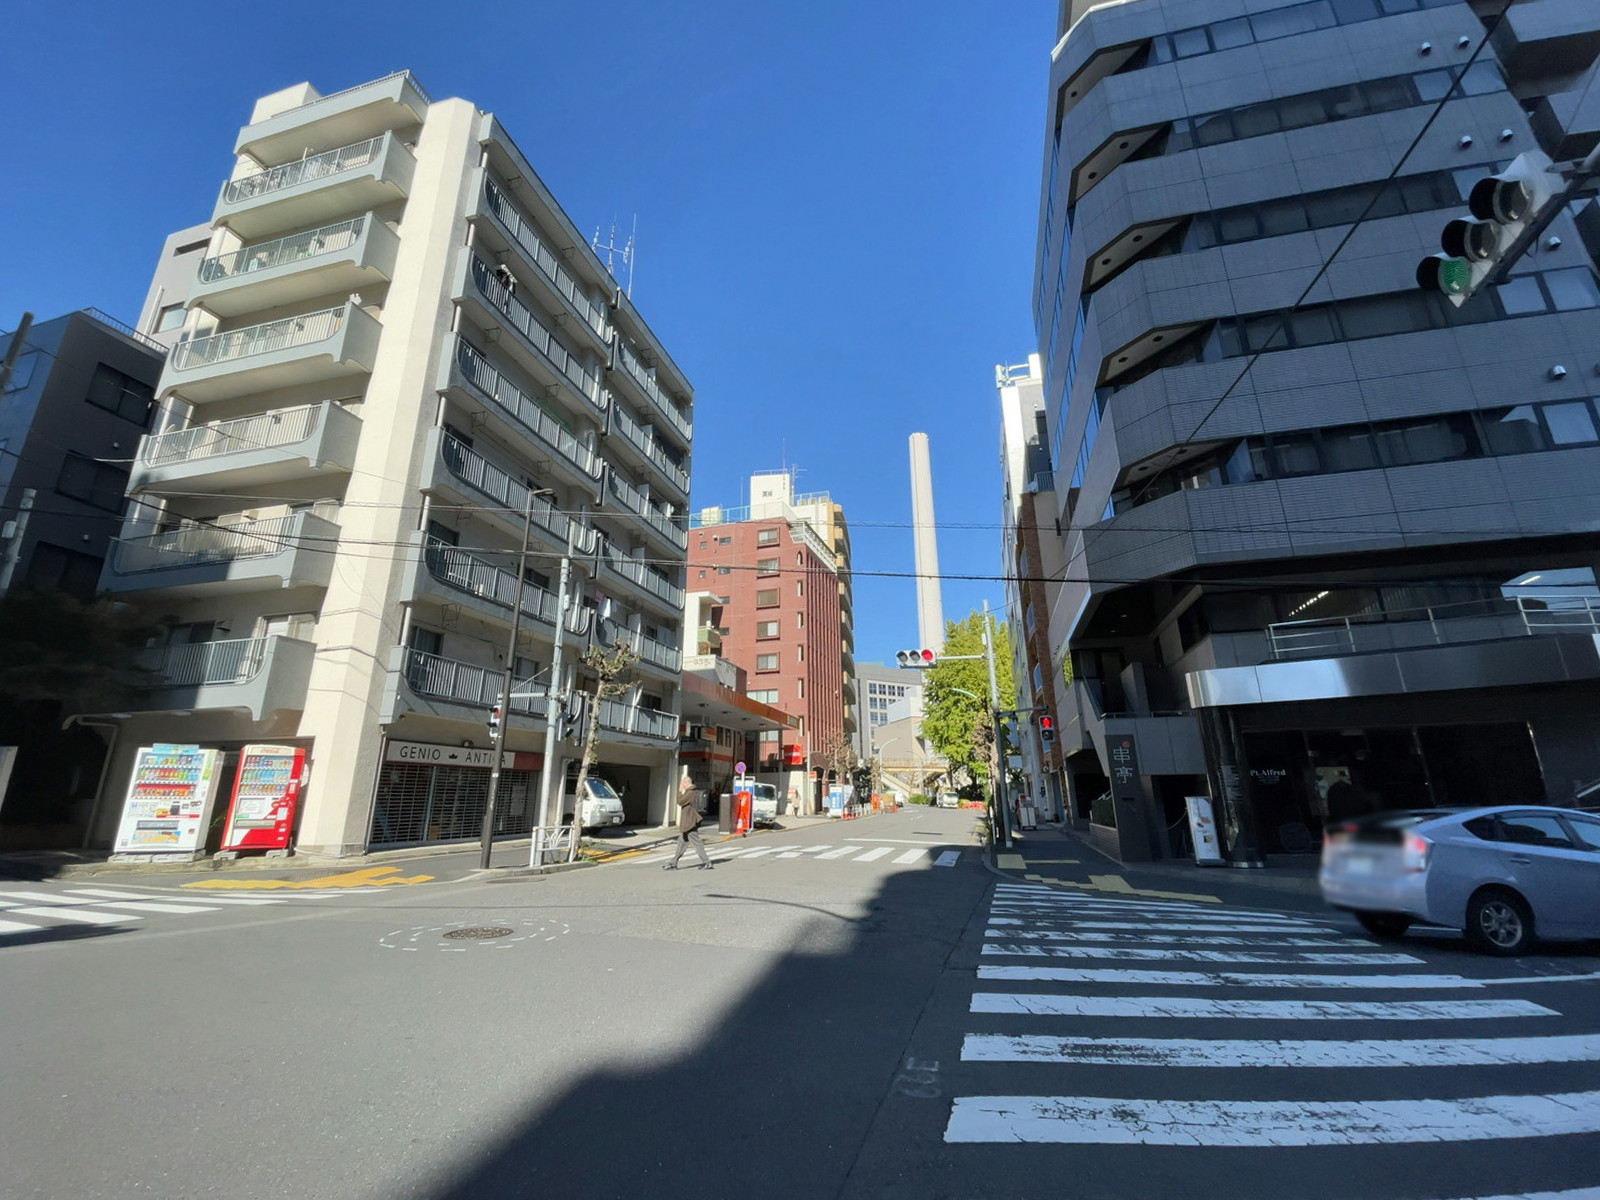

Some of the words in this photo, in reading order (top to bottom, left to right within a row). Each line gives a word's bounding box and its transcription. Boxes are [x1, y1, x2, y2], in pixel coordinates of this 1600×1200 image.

[400, 745, 441, 761] GENIO
[465, 751, 506, 765] ANTIA
[1112, 746, 1134, 784] 串亭
